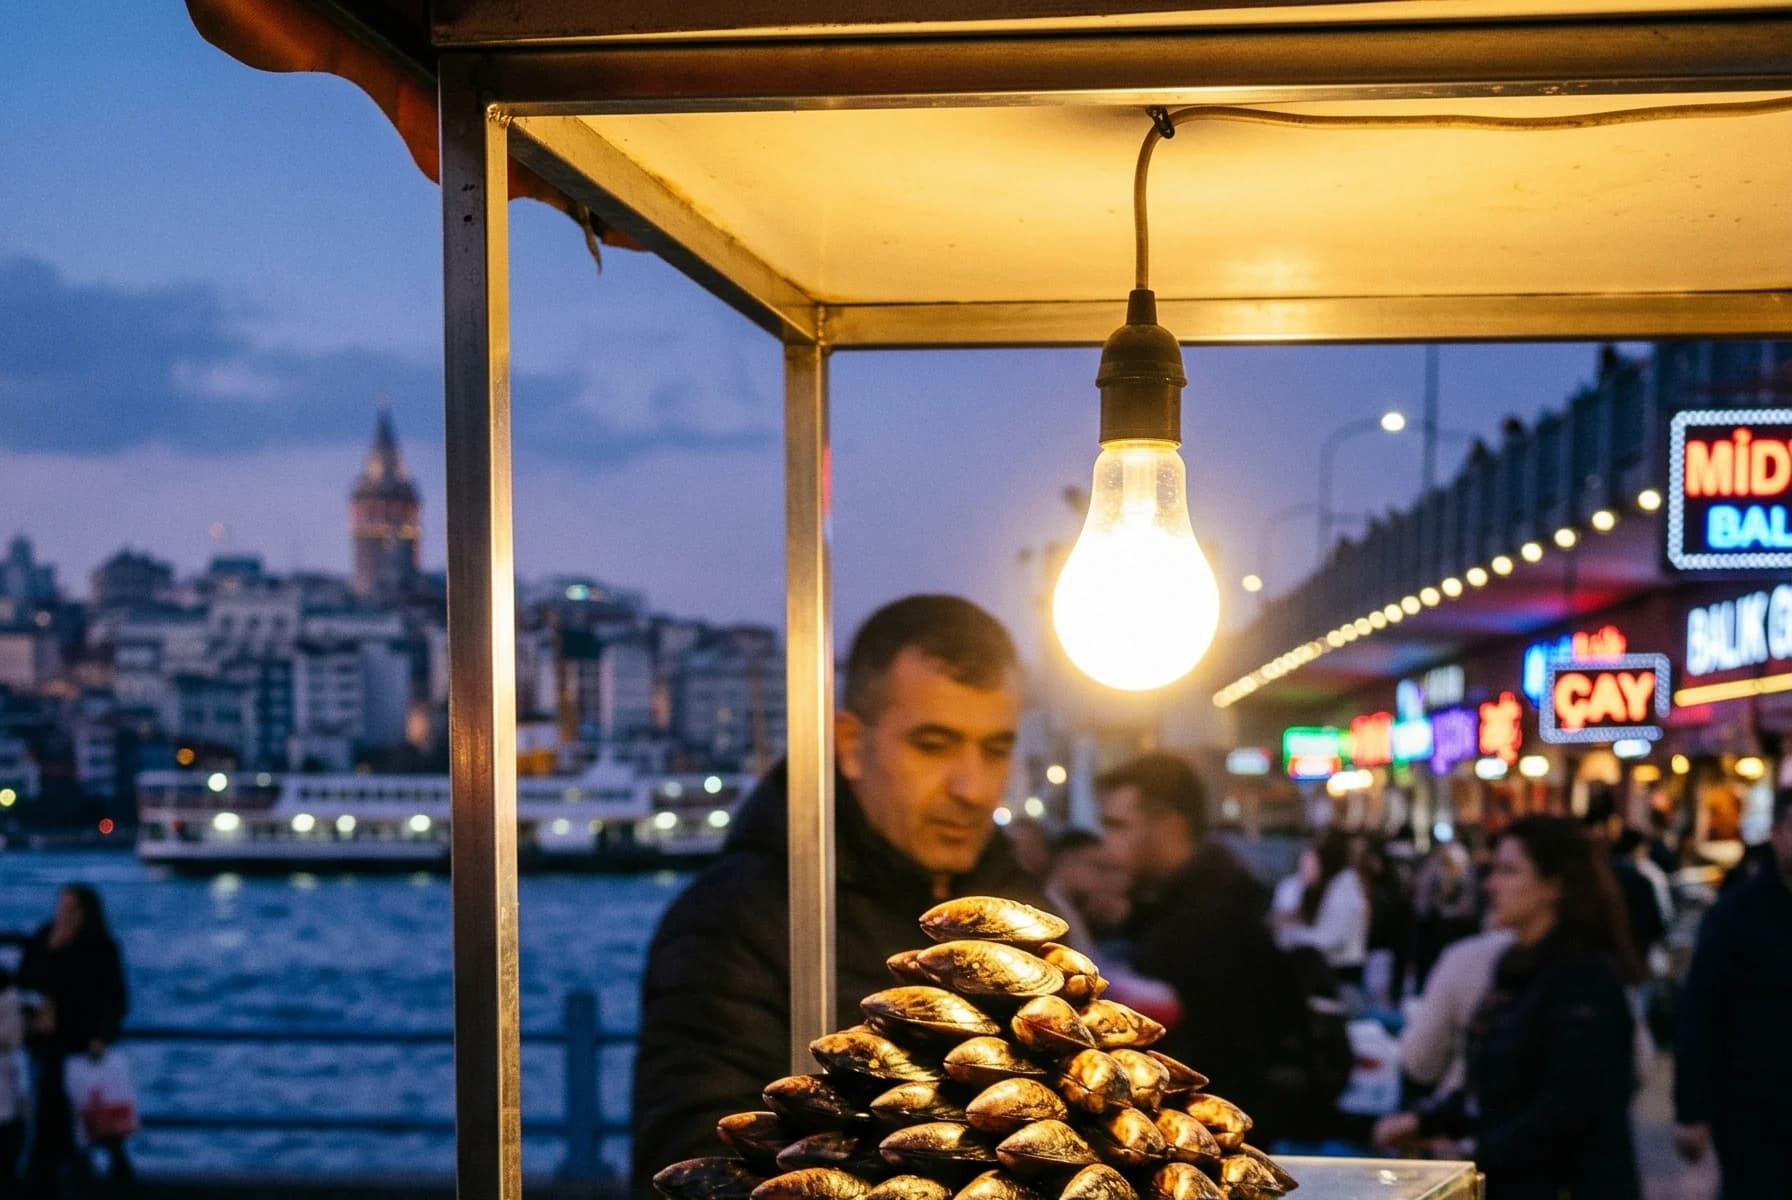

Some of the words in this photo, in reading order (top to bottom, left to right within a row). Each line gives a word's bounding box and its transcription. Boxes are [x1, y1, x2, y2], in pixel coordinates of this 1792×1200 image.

[1685, 427, 1792, 498] MİD
[1707, 504, 1792, 549] BAL
[1554, 671, 1656, 733] ÇAY
